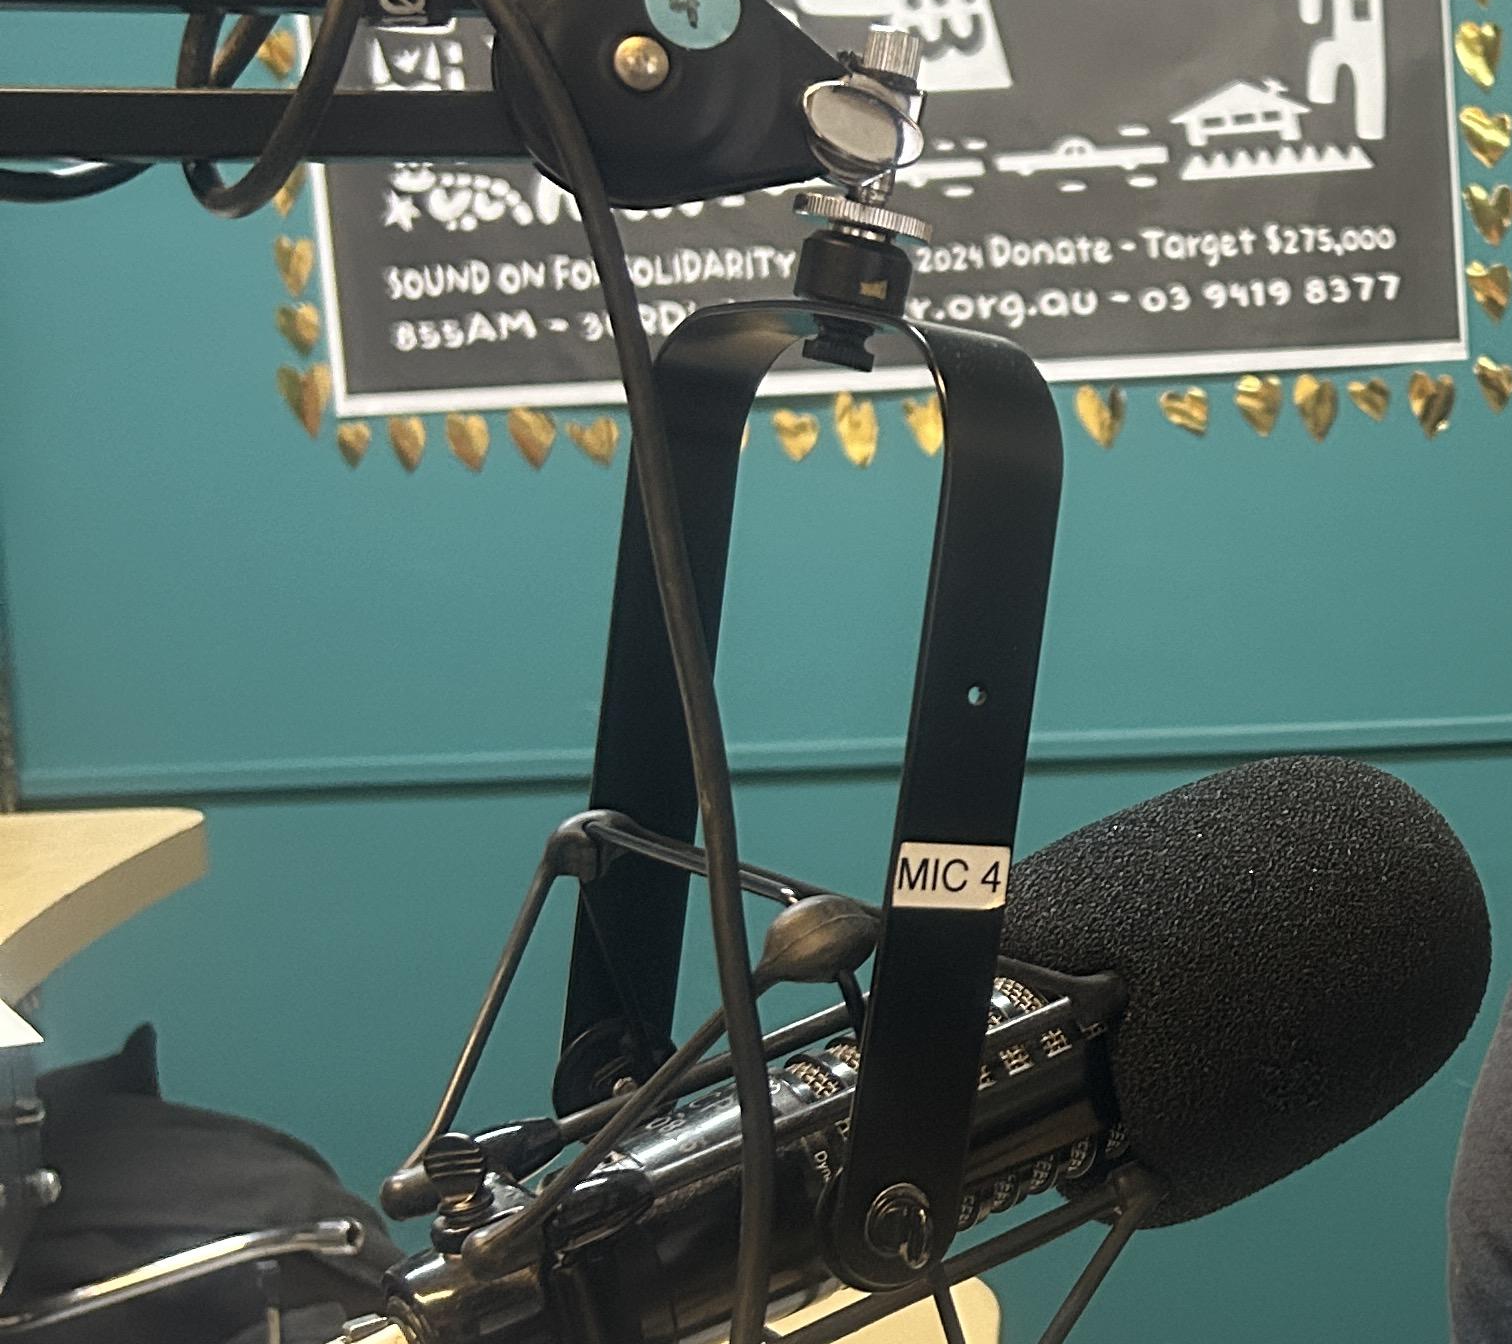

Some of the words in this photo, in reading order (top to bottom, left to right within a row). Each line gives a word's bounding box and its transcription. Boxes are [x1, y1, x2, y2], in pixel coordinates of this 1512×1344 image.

[386, 261, 488, 300] SOUND
[500, 261, 545, 299] ON
[625, 245, 797, 287] OLIDARITY
[915, 244, 984, 273] 2024
[986, 234, 1113, 268] Donate
[1141, 228, 1254, 266] Target
[1265, 223, 1396, 256] $275,000
[393, 308, 535, 351] 855AM
[1139, 284, 1191, 312] 03
[1203, 280, 1291, 309] 9419
[1304, 273, 1400, 304] 8377
[897, 857, 969, 892] MIC
[980, 860, 1001, 893] 4
